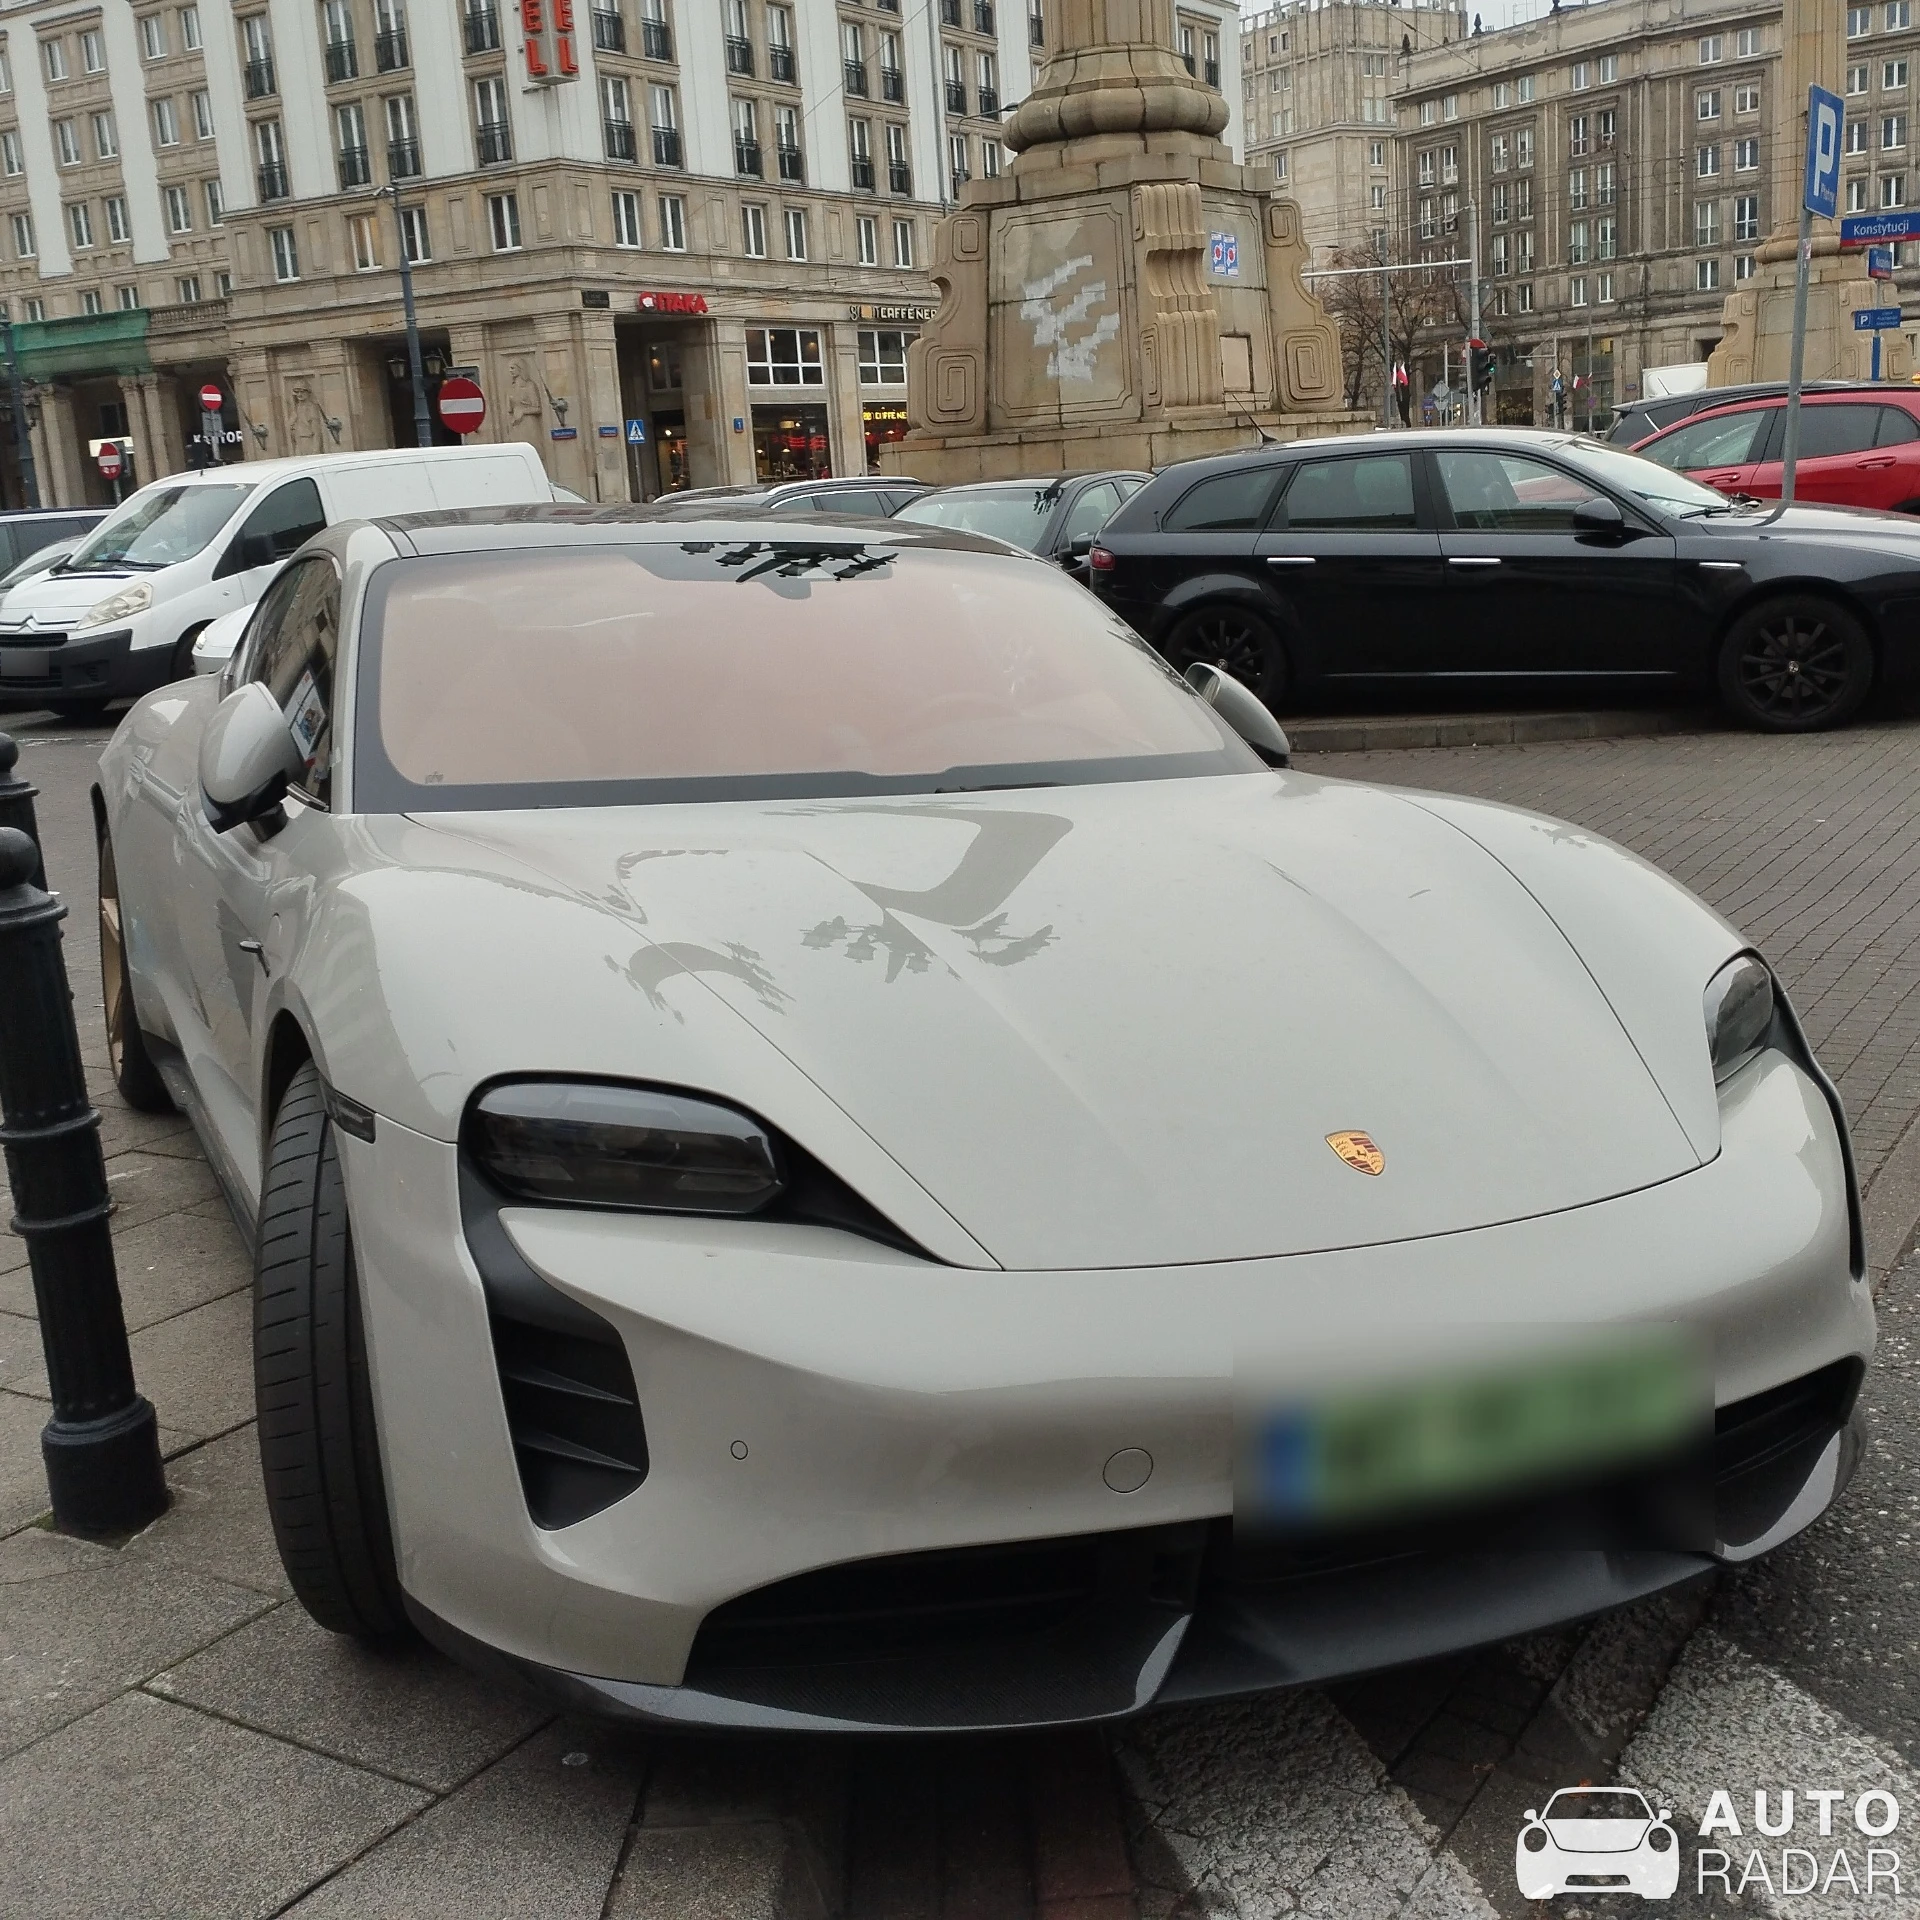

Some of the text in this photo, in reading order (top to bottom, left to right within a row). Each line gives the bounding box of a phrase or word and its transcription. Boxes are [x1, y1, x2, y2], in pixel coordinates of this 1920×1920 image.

[1813, 102, 1836, 196] P
[1853, 220, 1909, 236] Konstytucji
[656, 291, 708, 313] ITAKA
